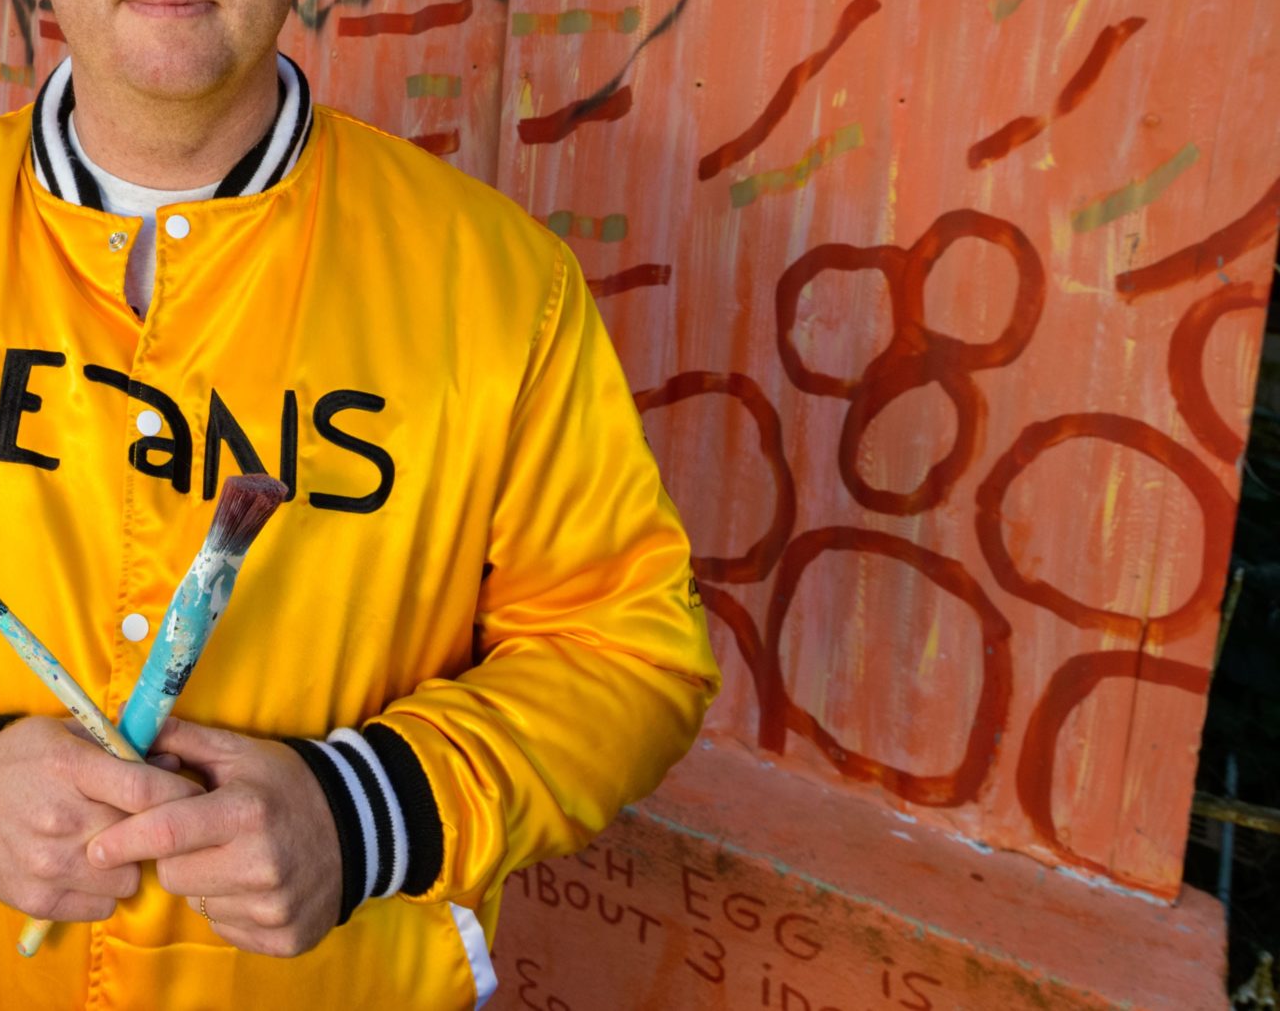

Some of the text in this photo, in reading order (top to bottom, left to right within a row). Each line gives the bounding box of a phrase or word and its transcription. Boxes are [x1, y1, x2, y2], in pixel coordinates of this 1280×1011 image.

[503, 861, 662, 944] ABOUT
[685, 928, 726, 984] 3
[682, 865, 823, 961] EGG
